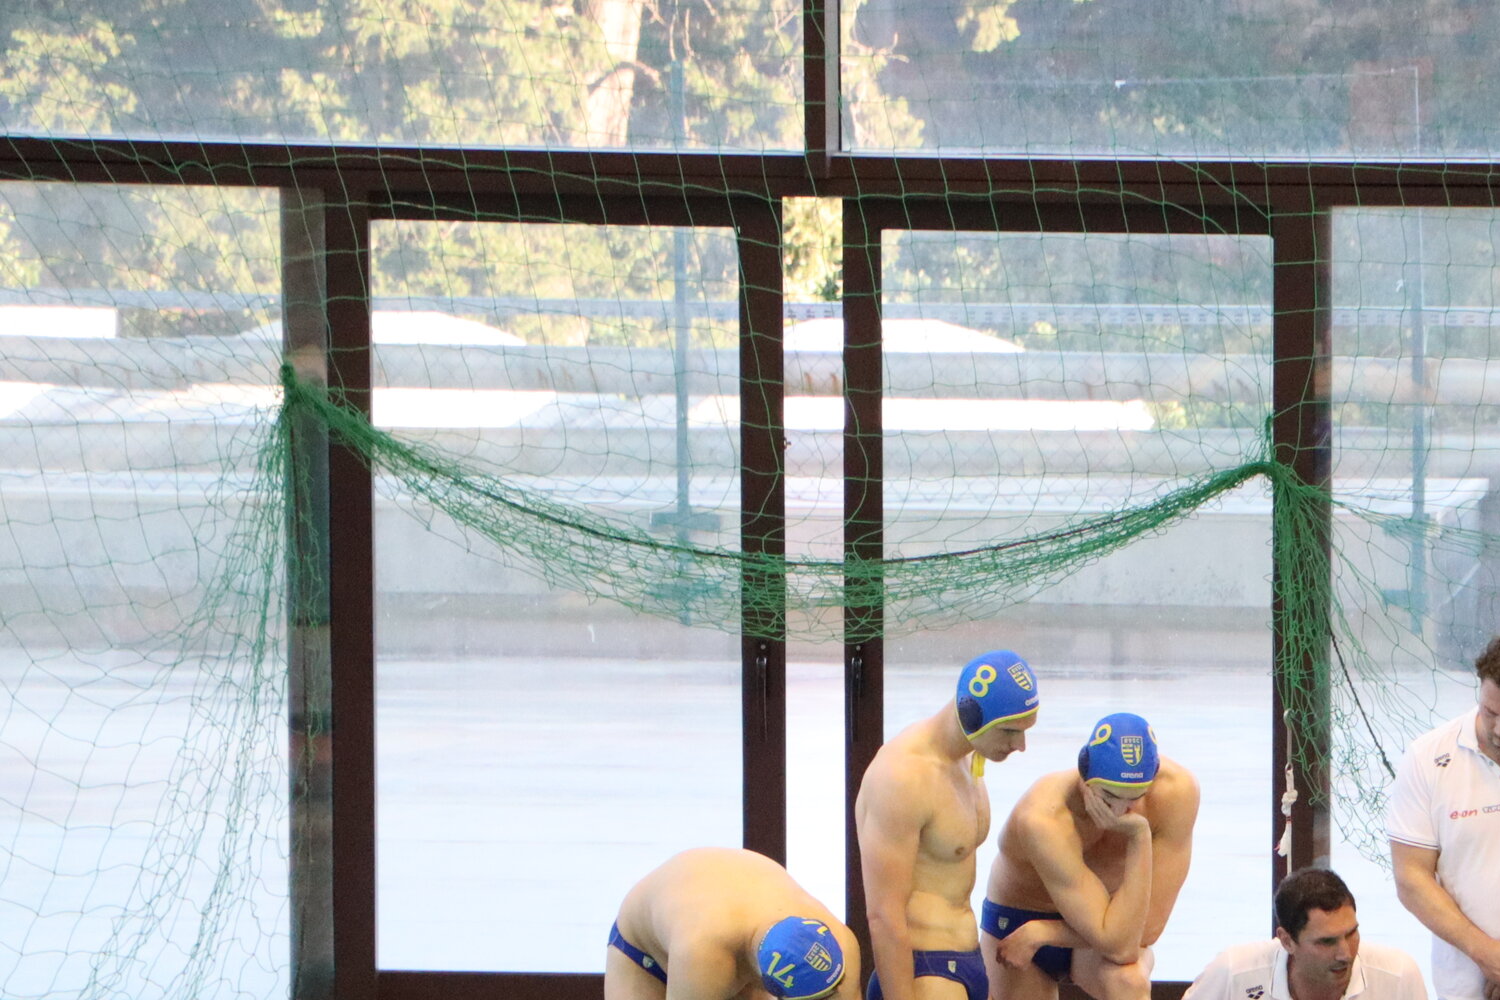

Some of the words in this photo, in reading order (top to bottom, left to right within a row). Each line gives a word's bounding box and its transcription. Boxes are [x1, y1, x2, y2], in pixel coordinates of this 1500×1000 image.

[968, 664, 997, 698] 8
[1089, 723, 1112, 747] 9
[767, 951, 796, 988] 14
